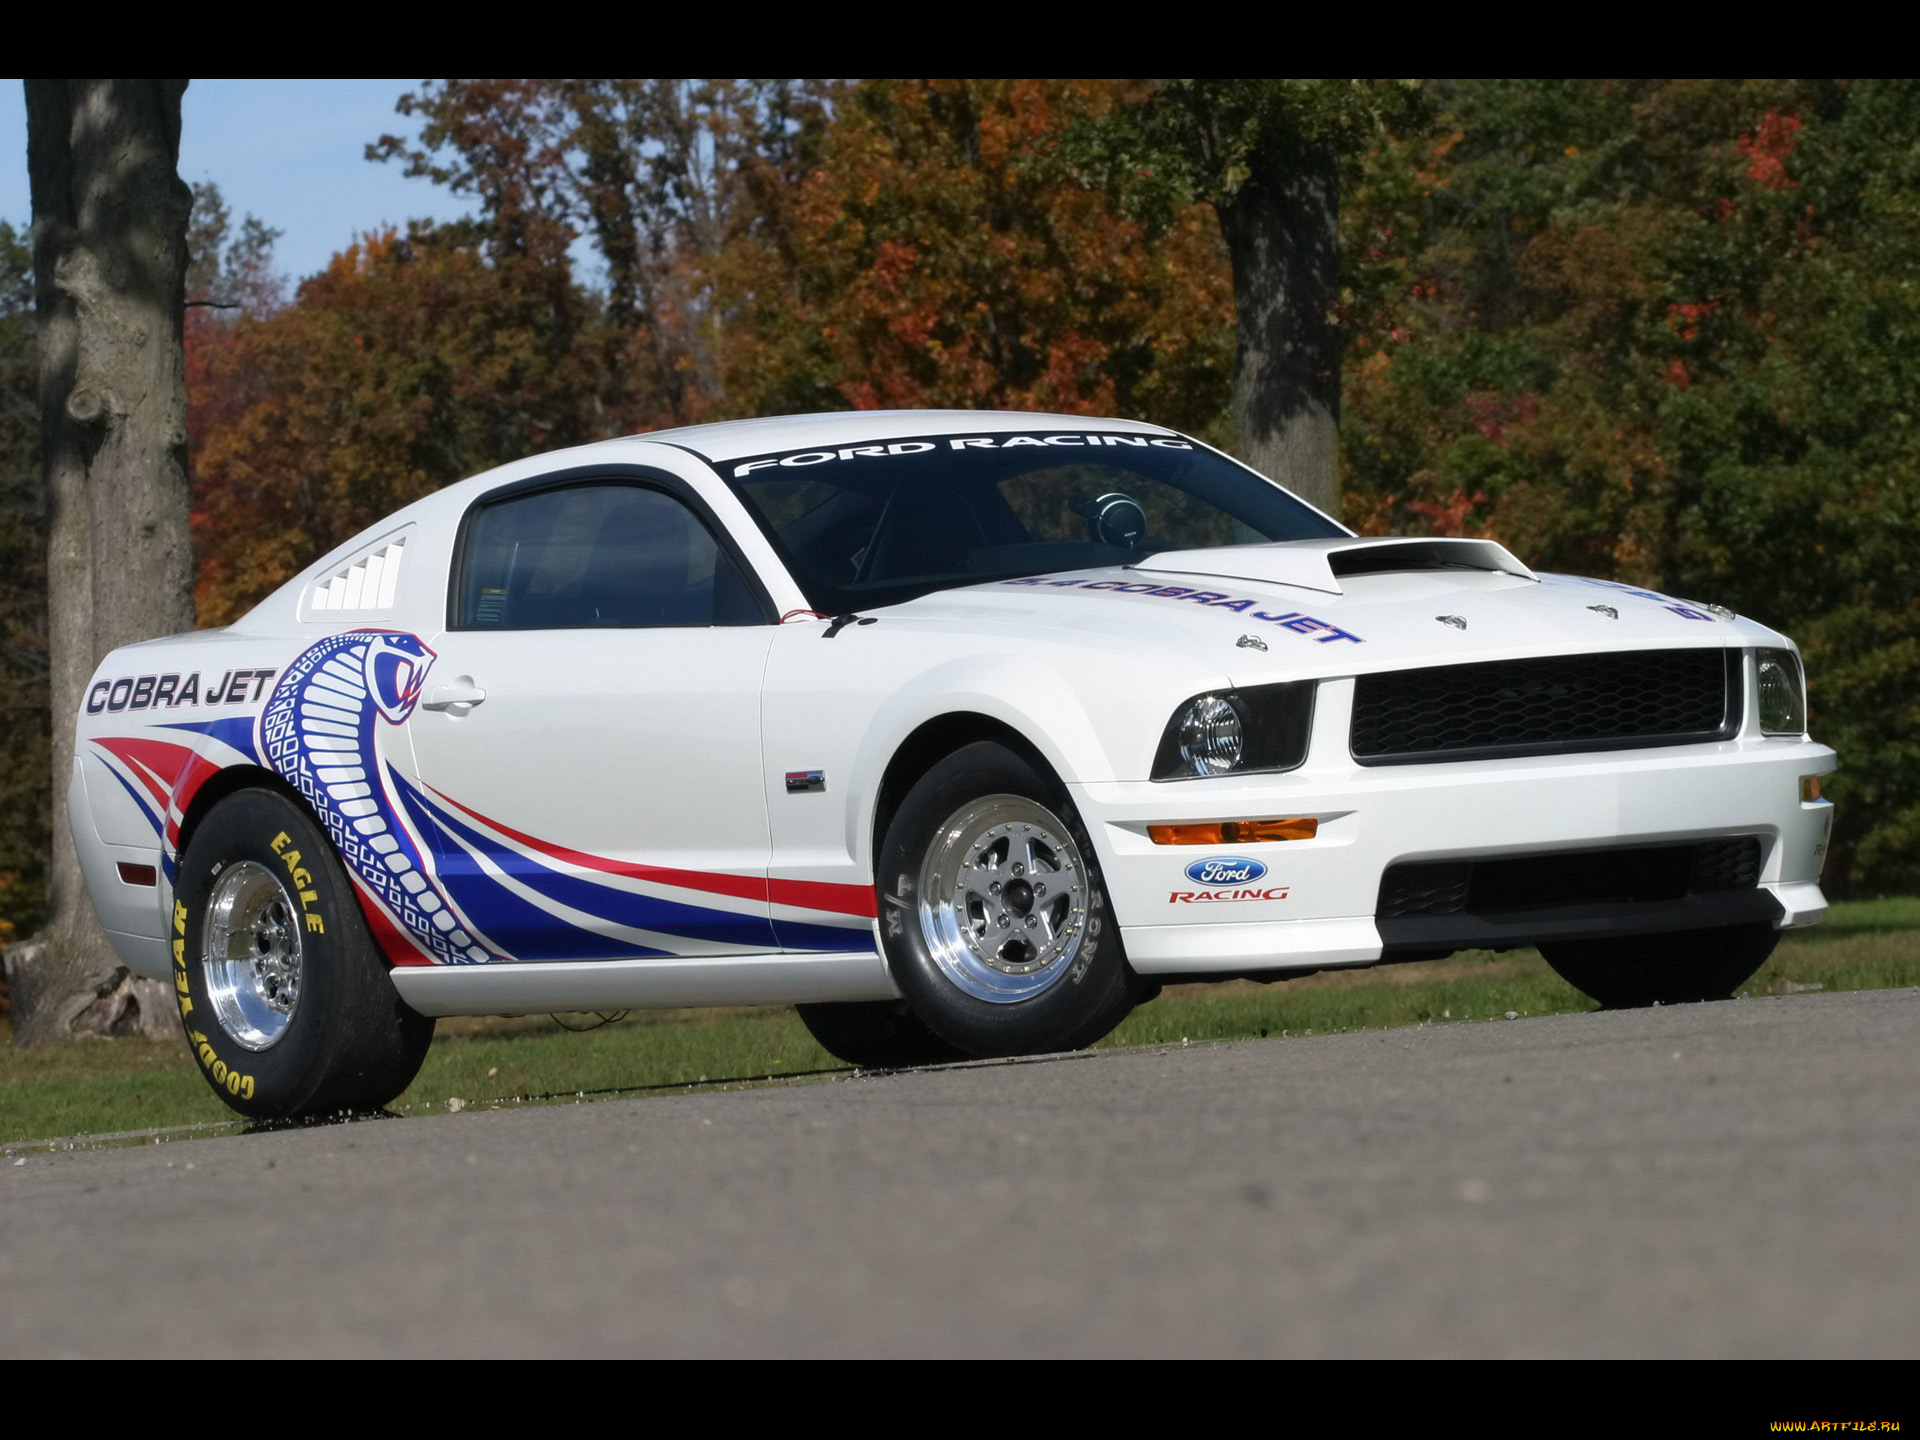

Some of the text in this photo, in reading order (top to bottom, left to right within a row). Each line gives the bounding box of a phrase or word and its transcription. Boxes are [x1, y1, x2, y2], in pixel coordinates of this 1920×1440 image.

[733, 434, 1194, 478] FORD RACING
[1076, 581, 1259, 613] COBRA
[1250, 611, 1367, 645] JET
[86, 667, 279, 716] COBRA JET
[270, 831, 324, 935] EAGLE
[1200, 861, 1250, 882] Ford
[1169, 887, 1290, 903] RACING
